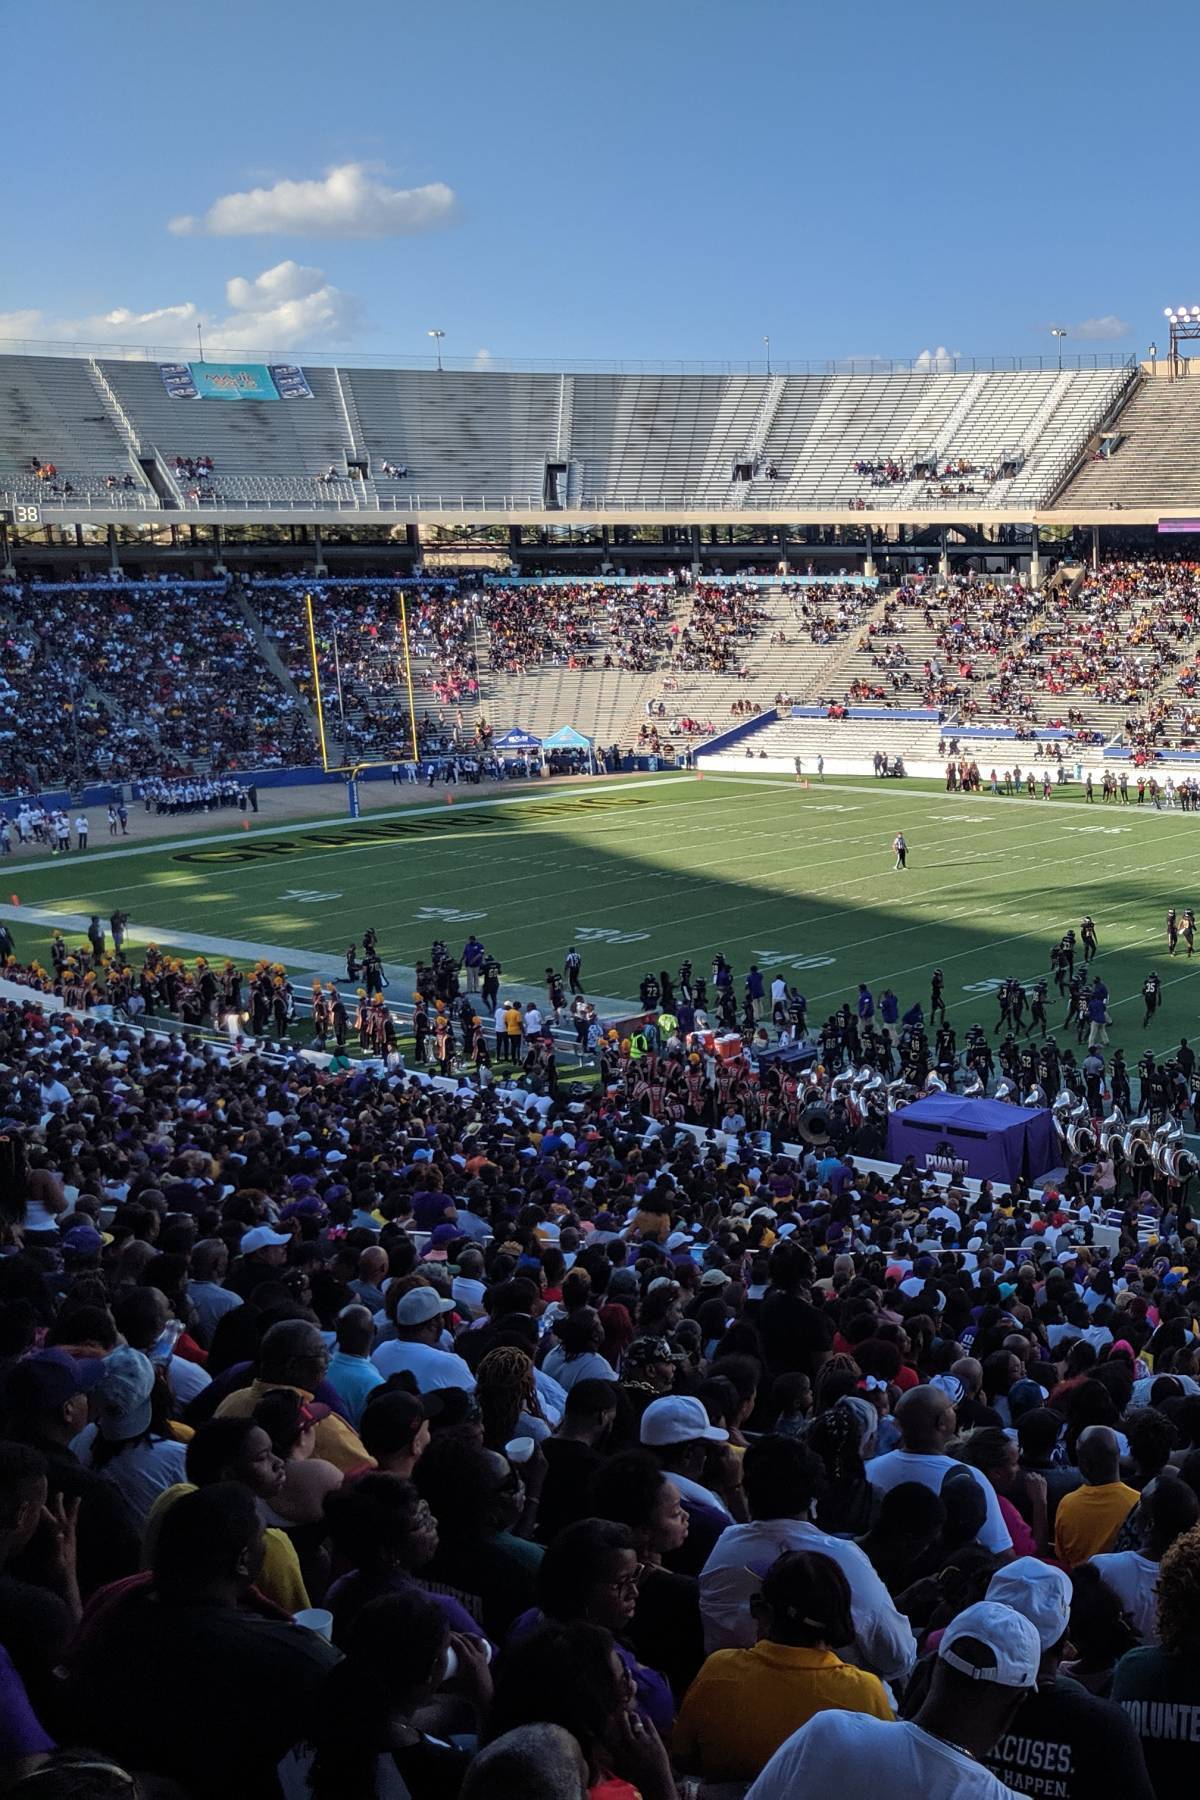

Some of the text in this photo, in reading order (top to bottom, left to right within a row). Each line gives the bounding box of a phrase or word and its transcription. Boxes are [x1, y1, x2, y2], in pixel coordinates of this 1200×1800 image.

[16, 506, 38, 522] 38
[172, 797, 652, 863] GRAMBLING
[1145, 982, 1155, 993] 35
[1003, 1769, 1071, 1799] HAPPEN.
